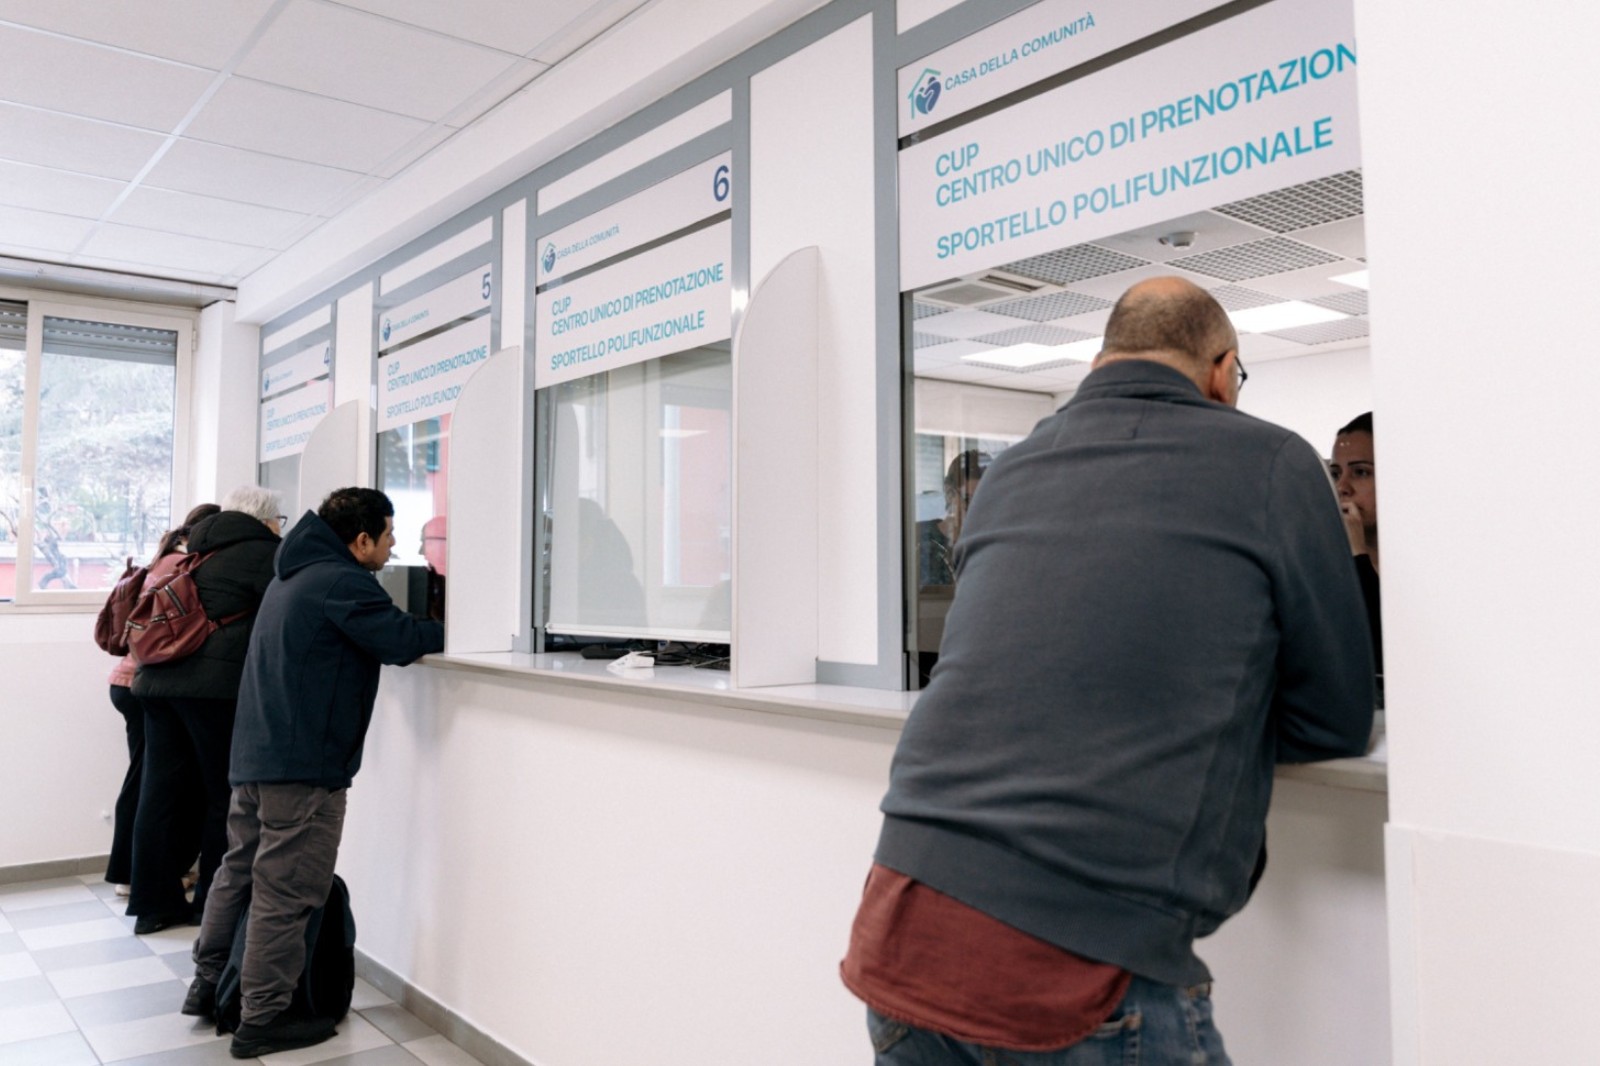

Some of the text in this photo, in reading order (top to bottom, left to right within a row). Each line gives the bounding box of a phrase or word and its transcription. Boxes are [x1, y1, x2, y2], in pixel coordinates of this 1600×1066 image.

[945, 12, 1096, 92] CASA DELLA COMUNITÀ
[935, 142, 979, 177] CUP
[935, 165, 1021, 208] CENTRO
[1026, 129, 1104, 177] UNICO
[1110, 117, 1135, 150] DI
[713, 165, 730, 202] 6
[936, 116, 1334, 260] SPORTELLO POLIFUNZIONALE
[556, 249, 571, 261] CASA
[571, 241, 589, 257] DELLA
[482, 272, 491, 300] 5
[551, 262, 724, 337] CENTRO UNICO DI PRENOTAZIONE
[551, 296, 571, 317] CUP
[551, 310, 705, 371] SPORTELLO POLIFUNZIONALE
[387, 361, 400, 376] CUP
[387, 374, 411, 392] CENTRO
[436, 345, 487, 374] PRENOTAZIONE
